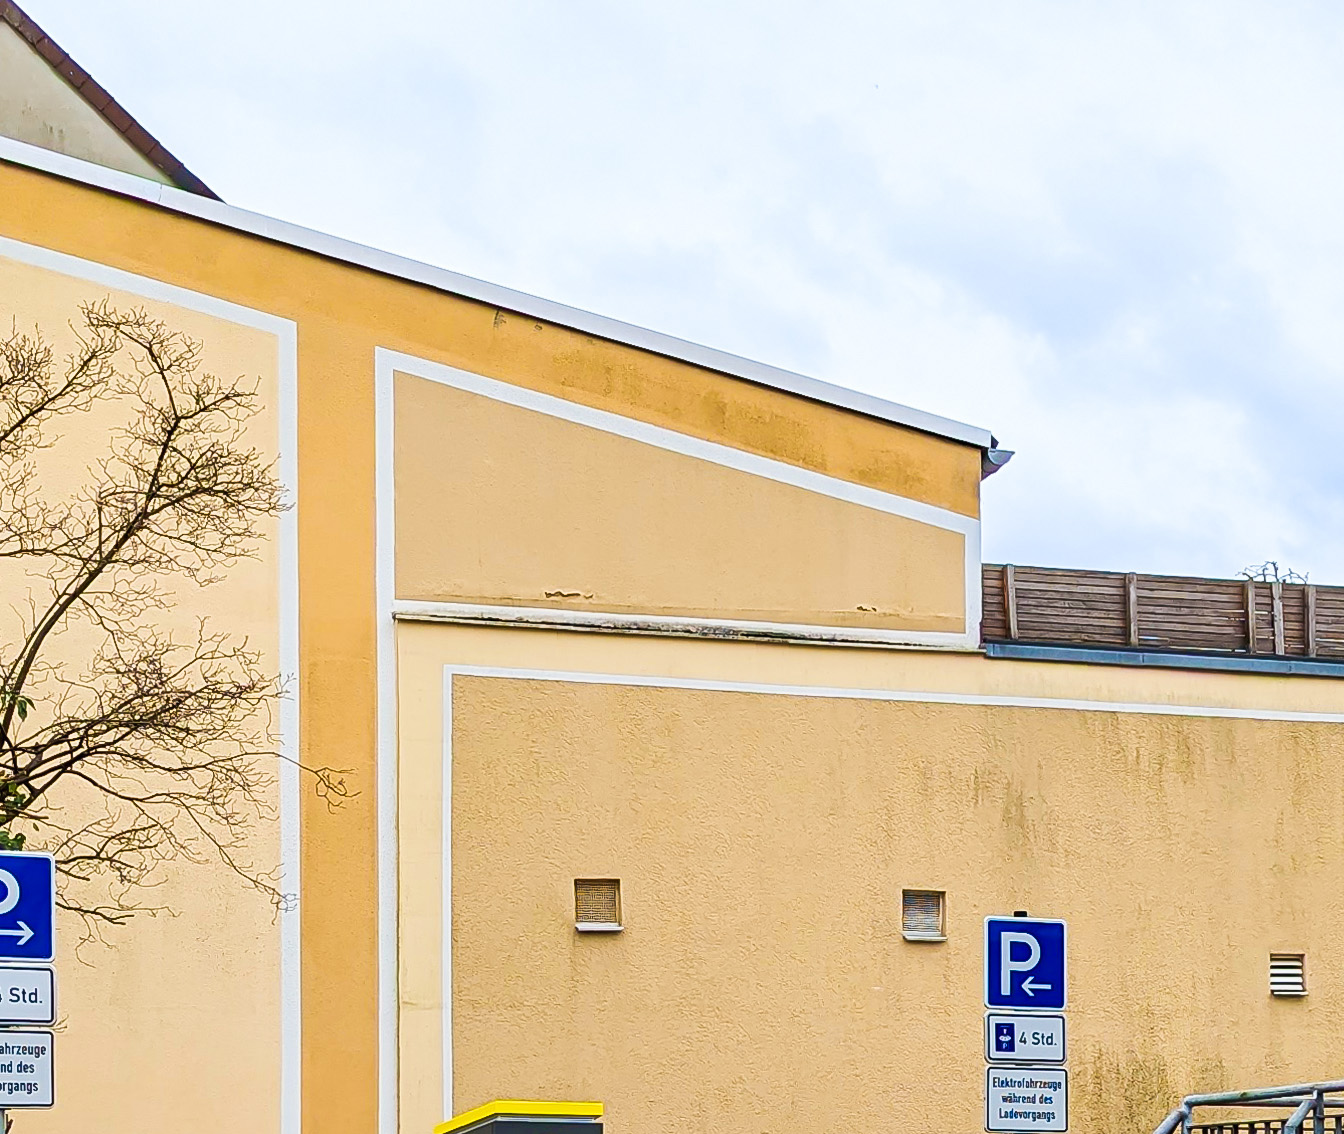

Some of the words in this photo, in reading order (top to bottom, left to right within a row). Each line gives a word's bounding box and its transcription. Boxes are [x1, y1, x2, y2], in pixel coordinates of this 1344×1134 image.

[1001, 932, 1041, 996] P
[9, 987, 43, 1004] Std.
[1019, 1032, 1027, 1045] 4
[1032, 1032, 1057, 1046] Std.
[17, 1061, 35, 1074] des
[992, 1077, 1062, 1091] Elektrofahrzeuge
[1002, 1094, 1036, 1105] während
[1039, 1094, 1053, 1105] des
[999, 1108, 1056, 1122] Ladevorgangs
